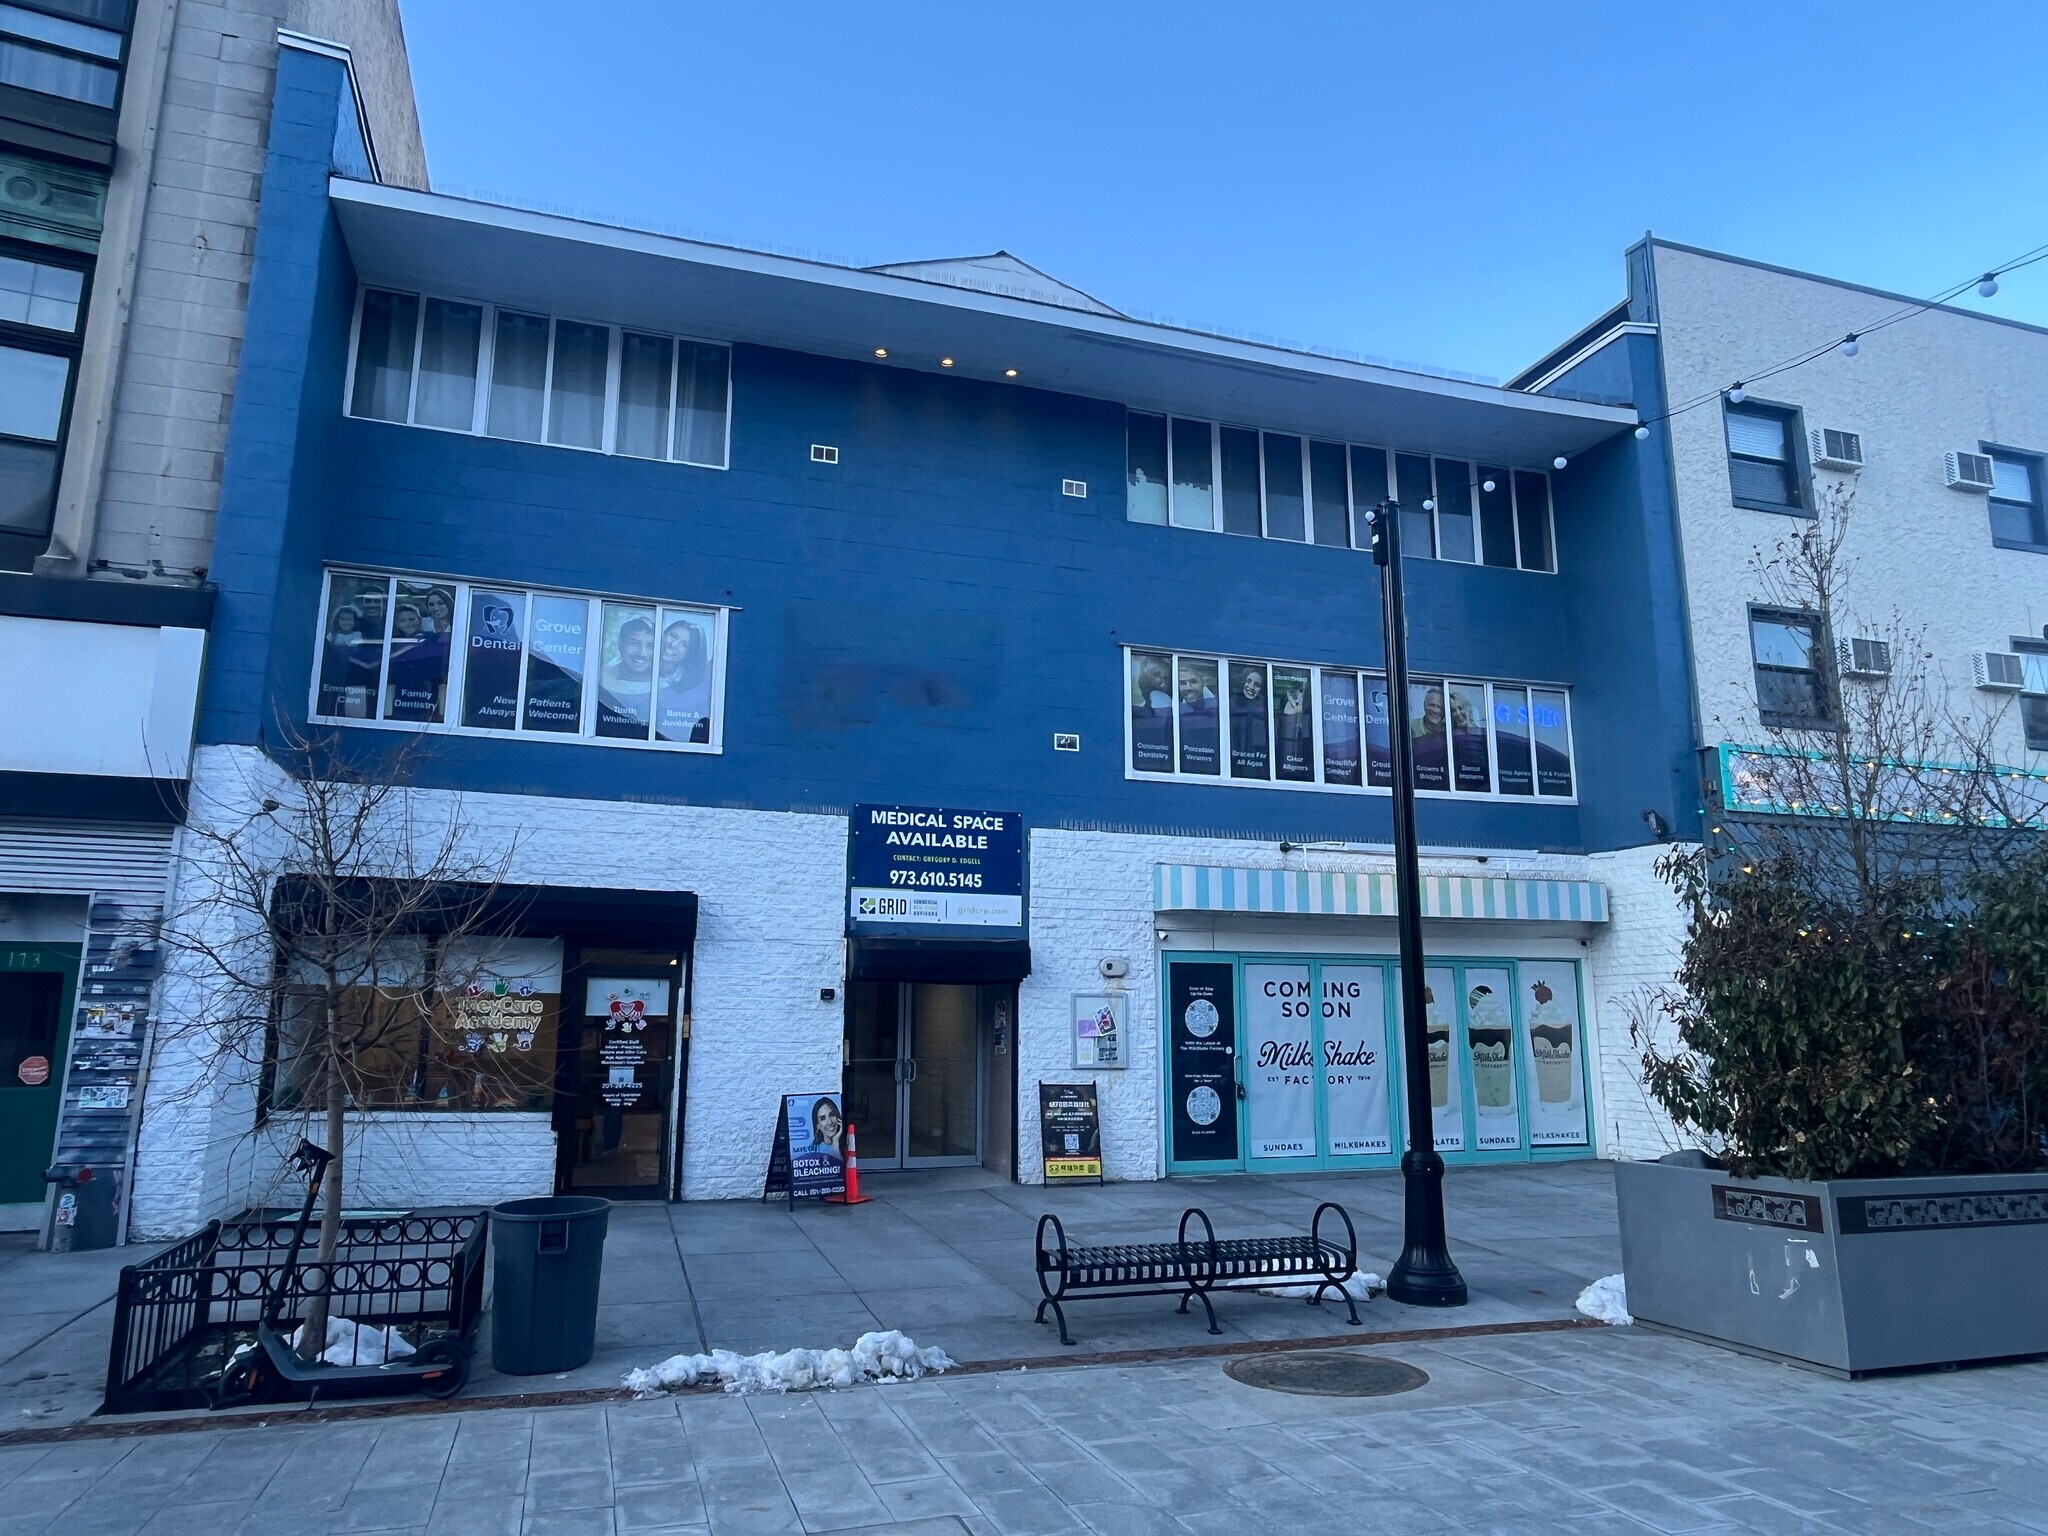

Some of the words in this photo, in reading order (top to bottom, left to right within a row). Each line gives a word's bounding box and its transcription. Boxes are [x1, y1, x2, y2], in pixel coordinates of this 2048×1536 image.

[535, 618, 581, 634] Grove
[472, 636, 521, 650] Dental
[533, 641, 584, 654] Center
[401, 689, 432, 700] Family
[1323, 695, 1355, 707] Grove
[394, 699, 438, 710] Dentistry
[493, 696, 517, 705] New
[529, 697, 571, 708] Patients
[478, 707, 516, 718] Always
[528, 709, 578, 721] Welcome!
[1323, 712, 1358, 723] Center
[1366, 715, 1390, 726] Den
[1138, 751, 1169, 760] Dentistry
[1325, 758, 1357, 767] Beautiful
[1371, 761, 1391, 769] Creat
[1375, 770, 1391, 778] Heal
[871, 810, 947, 828] MEDICAL
[953, 815, 1004, 831] SPACE
[886, 831, 988, 849] AVAILABLE
[889, 870, 982, 888] 973.610.5145
[879, 898, 907, 915] GRID
[9, 951, 41, 967] 173
[1264, 981, 1361, 998] COMING
[455, 996, 544, 1016] TheyCare
[1282, 1002, 1351, 1018] SOON
[455, 1012, 542, 1033] Academy
[1285, 1075, 1353, 1085] FACORY
[1533, 1131, 1580, 1140] MILKSHAKES
[1263, 1143, 1303, 1152] SUNDAES
[1335, 1141, 1387, 1149] MILKSHAKES
[1479, 1137, 1516, 1145] SUNDAES
[793, 1159, 820, 1168] BOTOX
[822, 1155, 830, 1166] &
[793, 1166, 840, 1177] BLEACHING!
